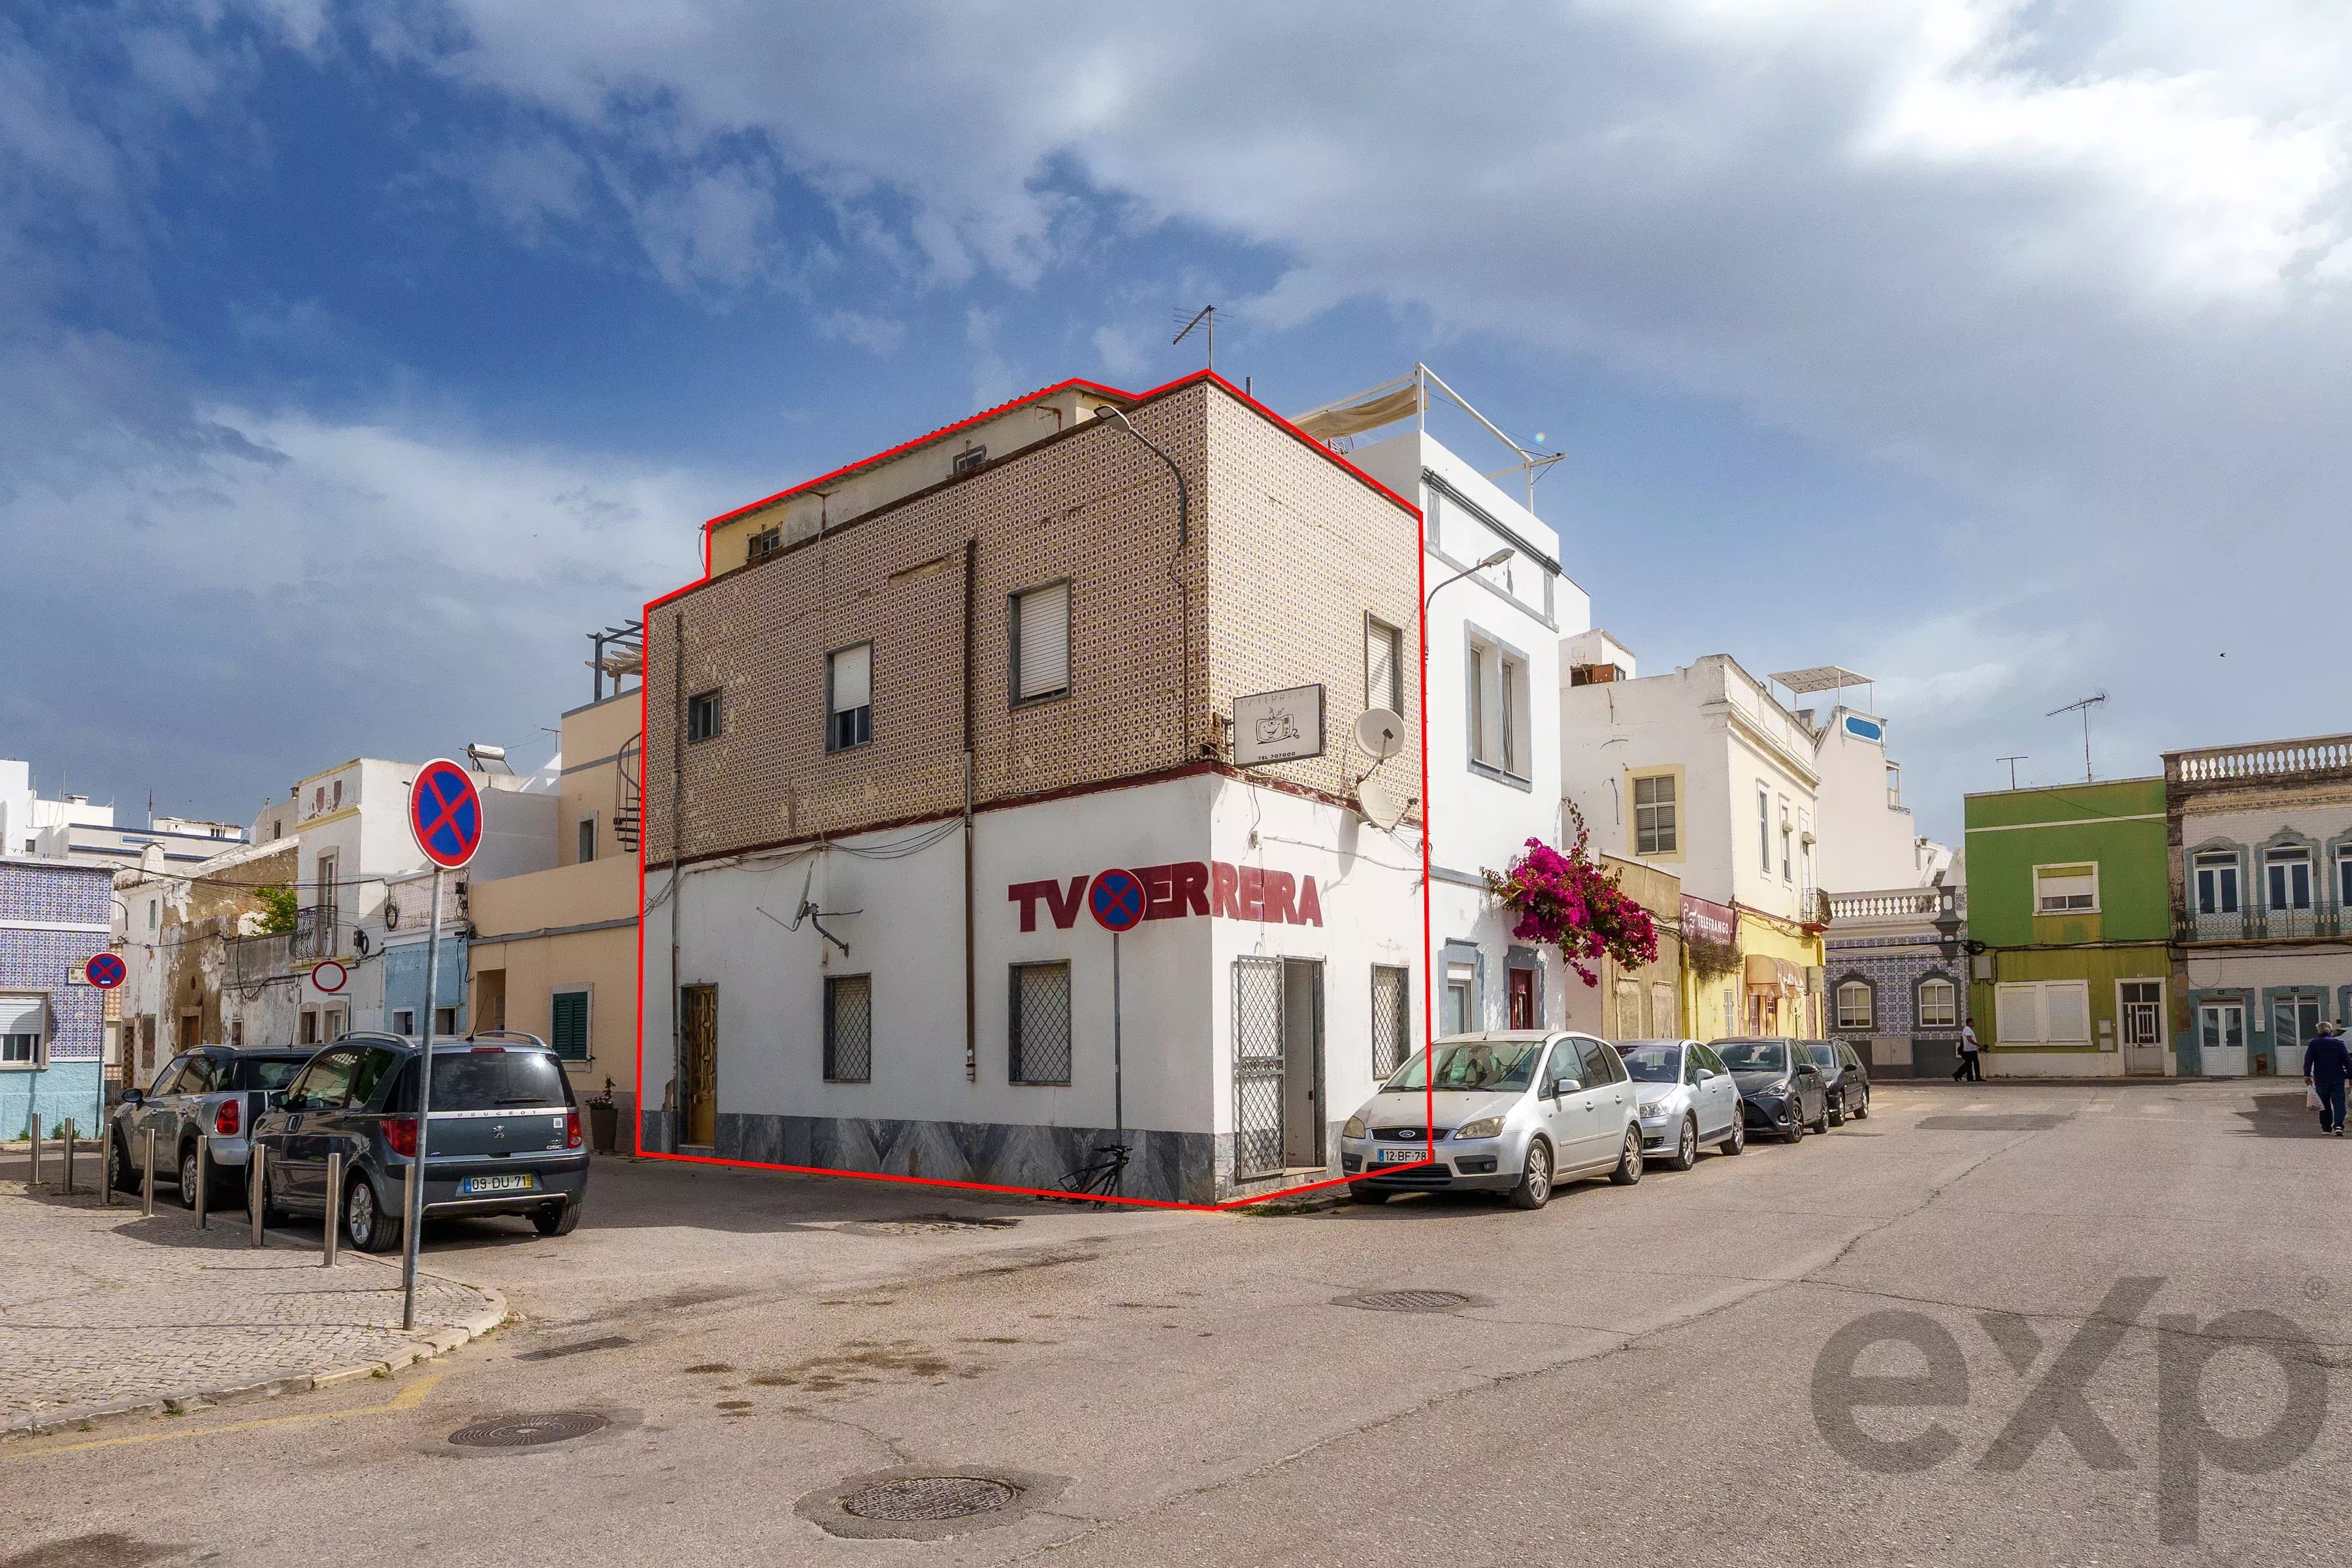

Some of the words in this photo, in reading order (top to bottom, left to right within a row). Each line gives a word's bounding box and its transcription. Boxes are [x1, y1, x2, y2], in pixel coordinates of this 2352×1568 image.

[1239, 699, 1253, 709] TV
[1008, 874, 1090, 932] TV
[1697, 914, 1729, 935] TELEFRANGO
